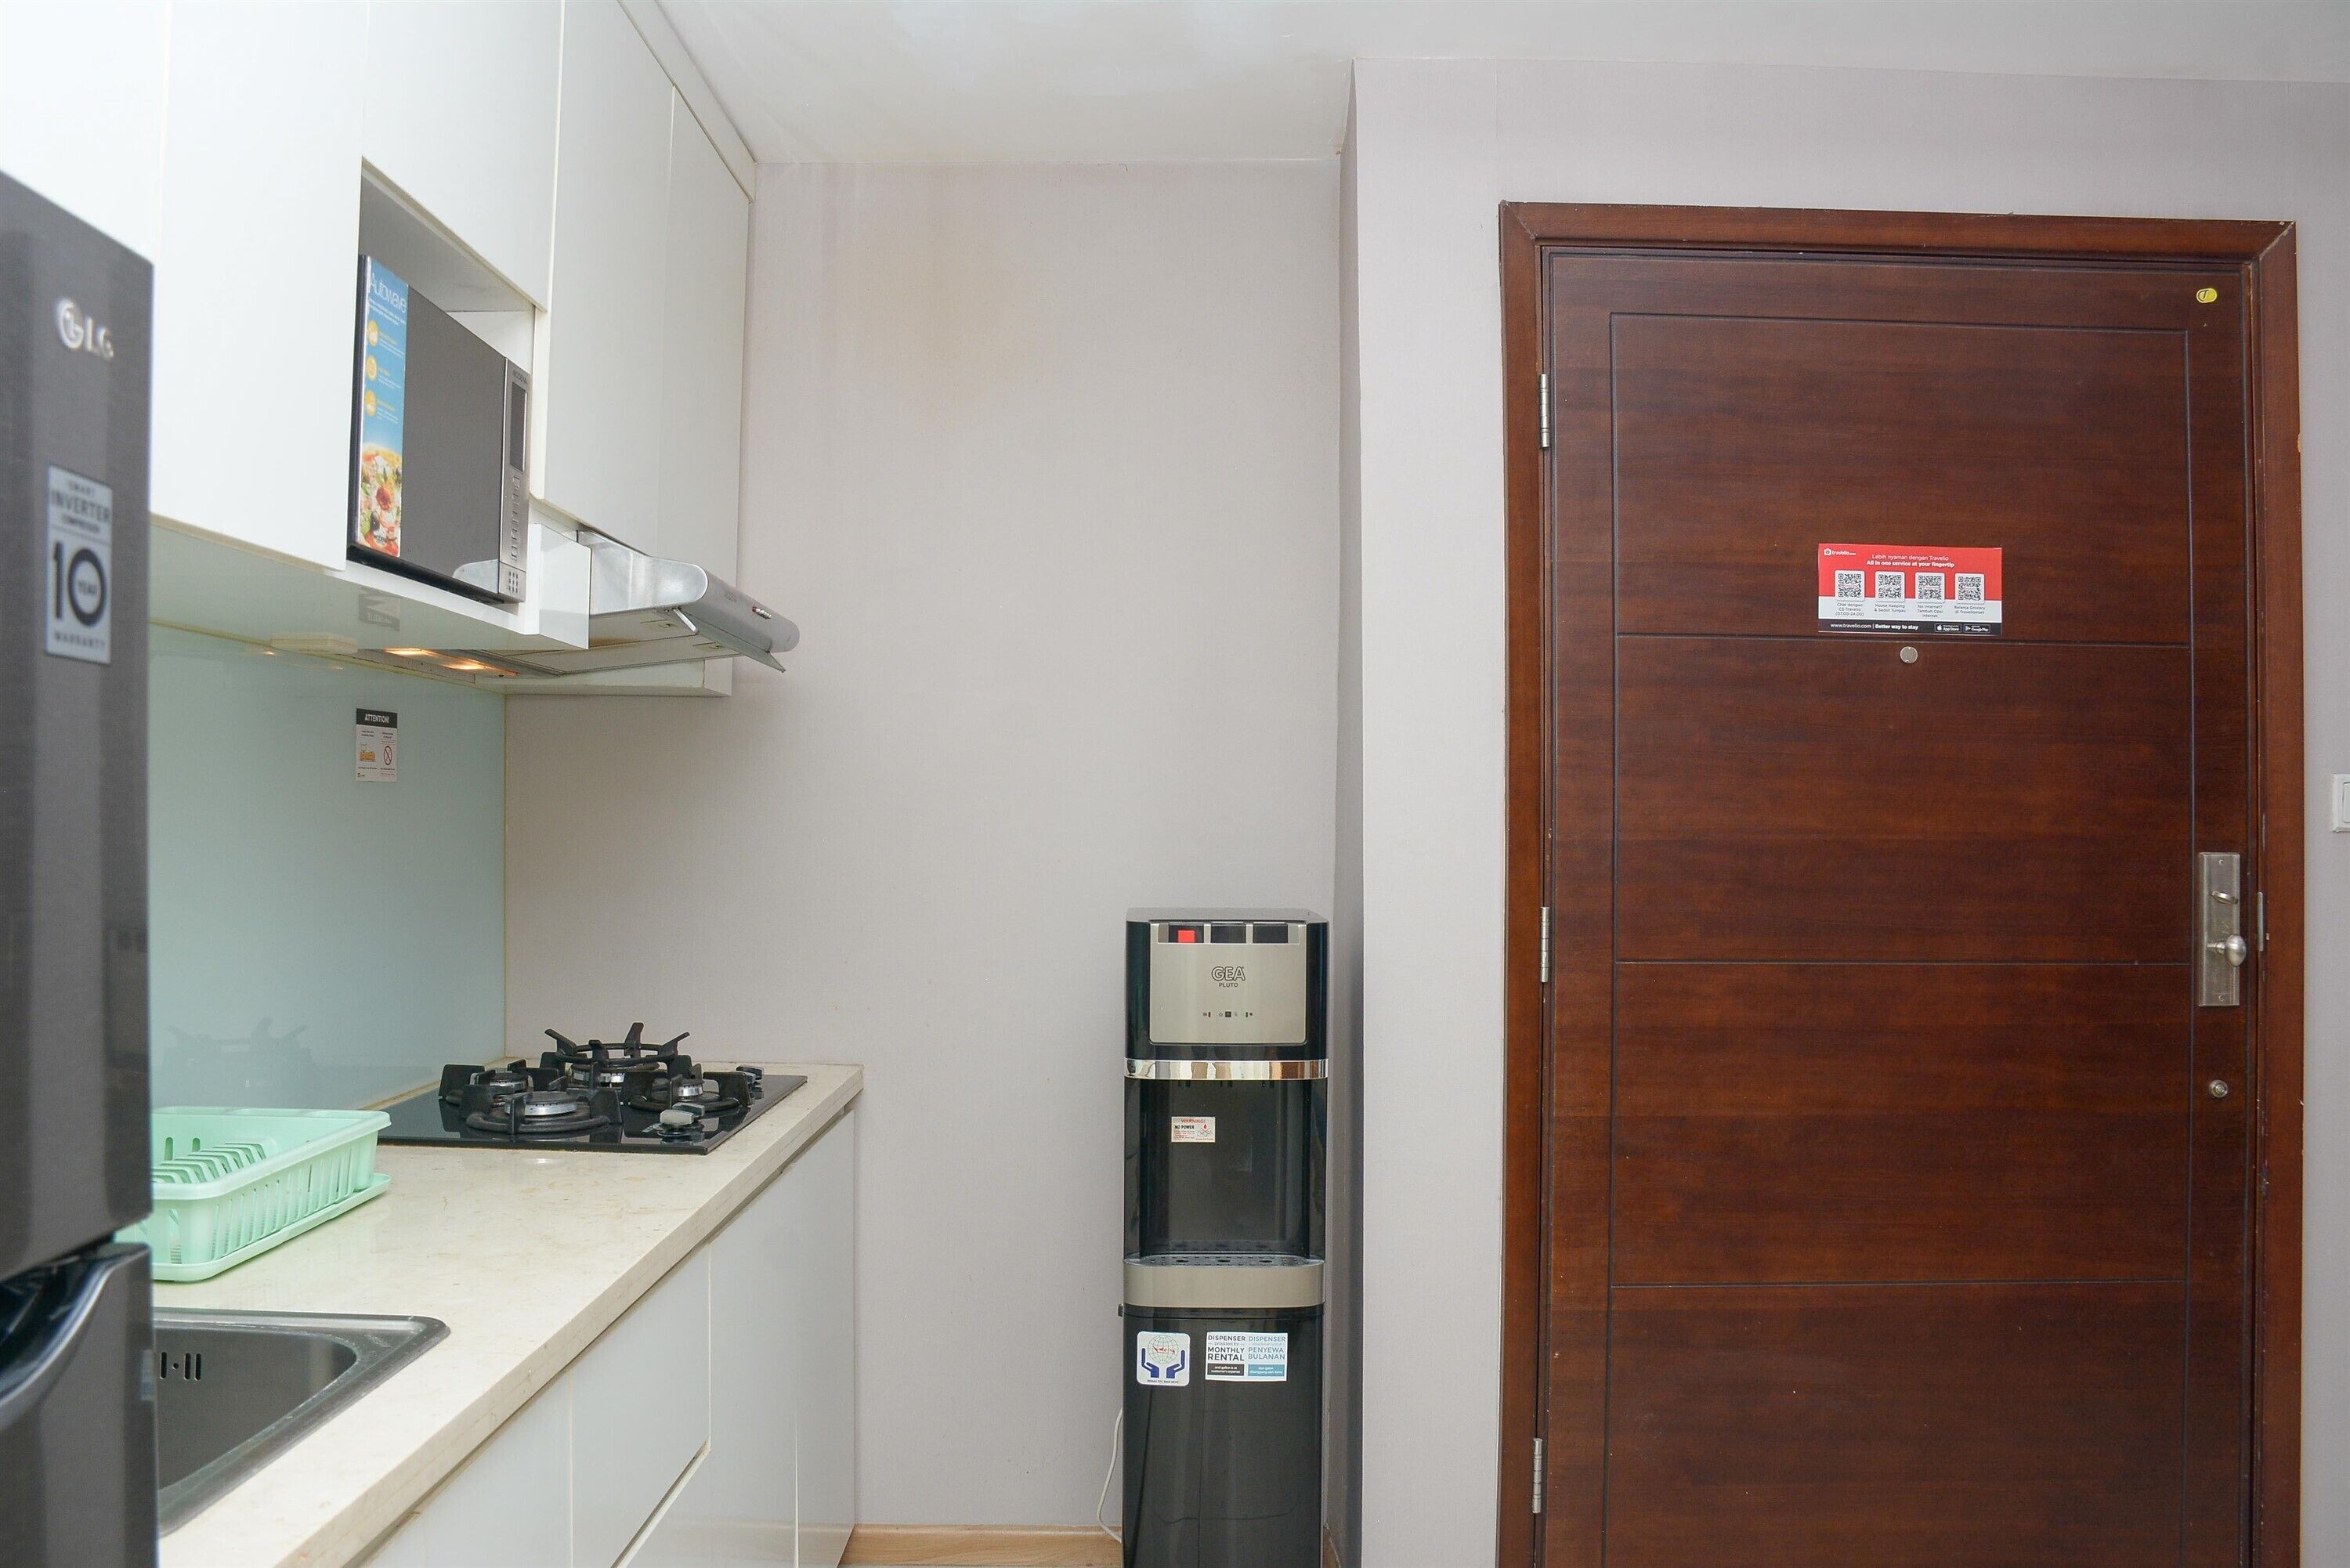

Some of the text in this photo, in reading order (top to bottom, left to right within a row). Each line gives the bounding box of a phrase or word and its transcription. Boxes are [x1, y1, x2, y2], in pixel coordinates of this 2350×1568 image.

[50, 489, 112, 523] INVERTER
[54, 540, 107, 628] 10
[1211, 966, 1246, 981] GEA
